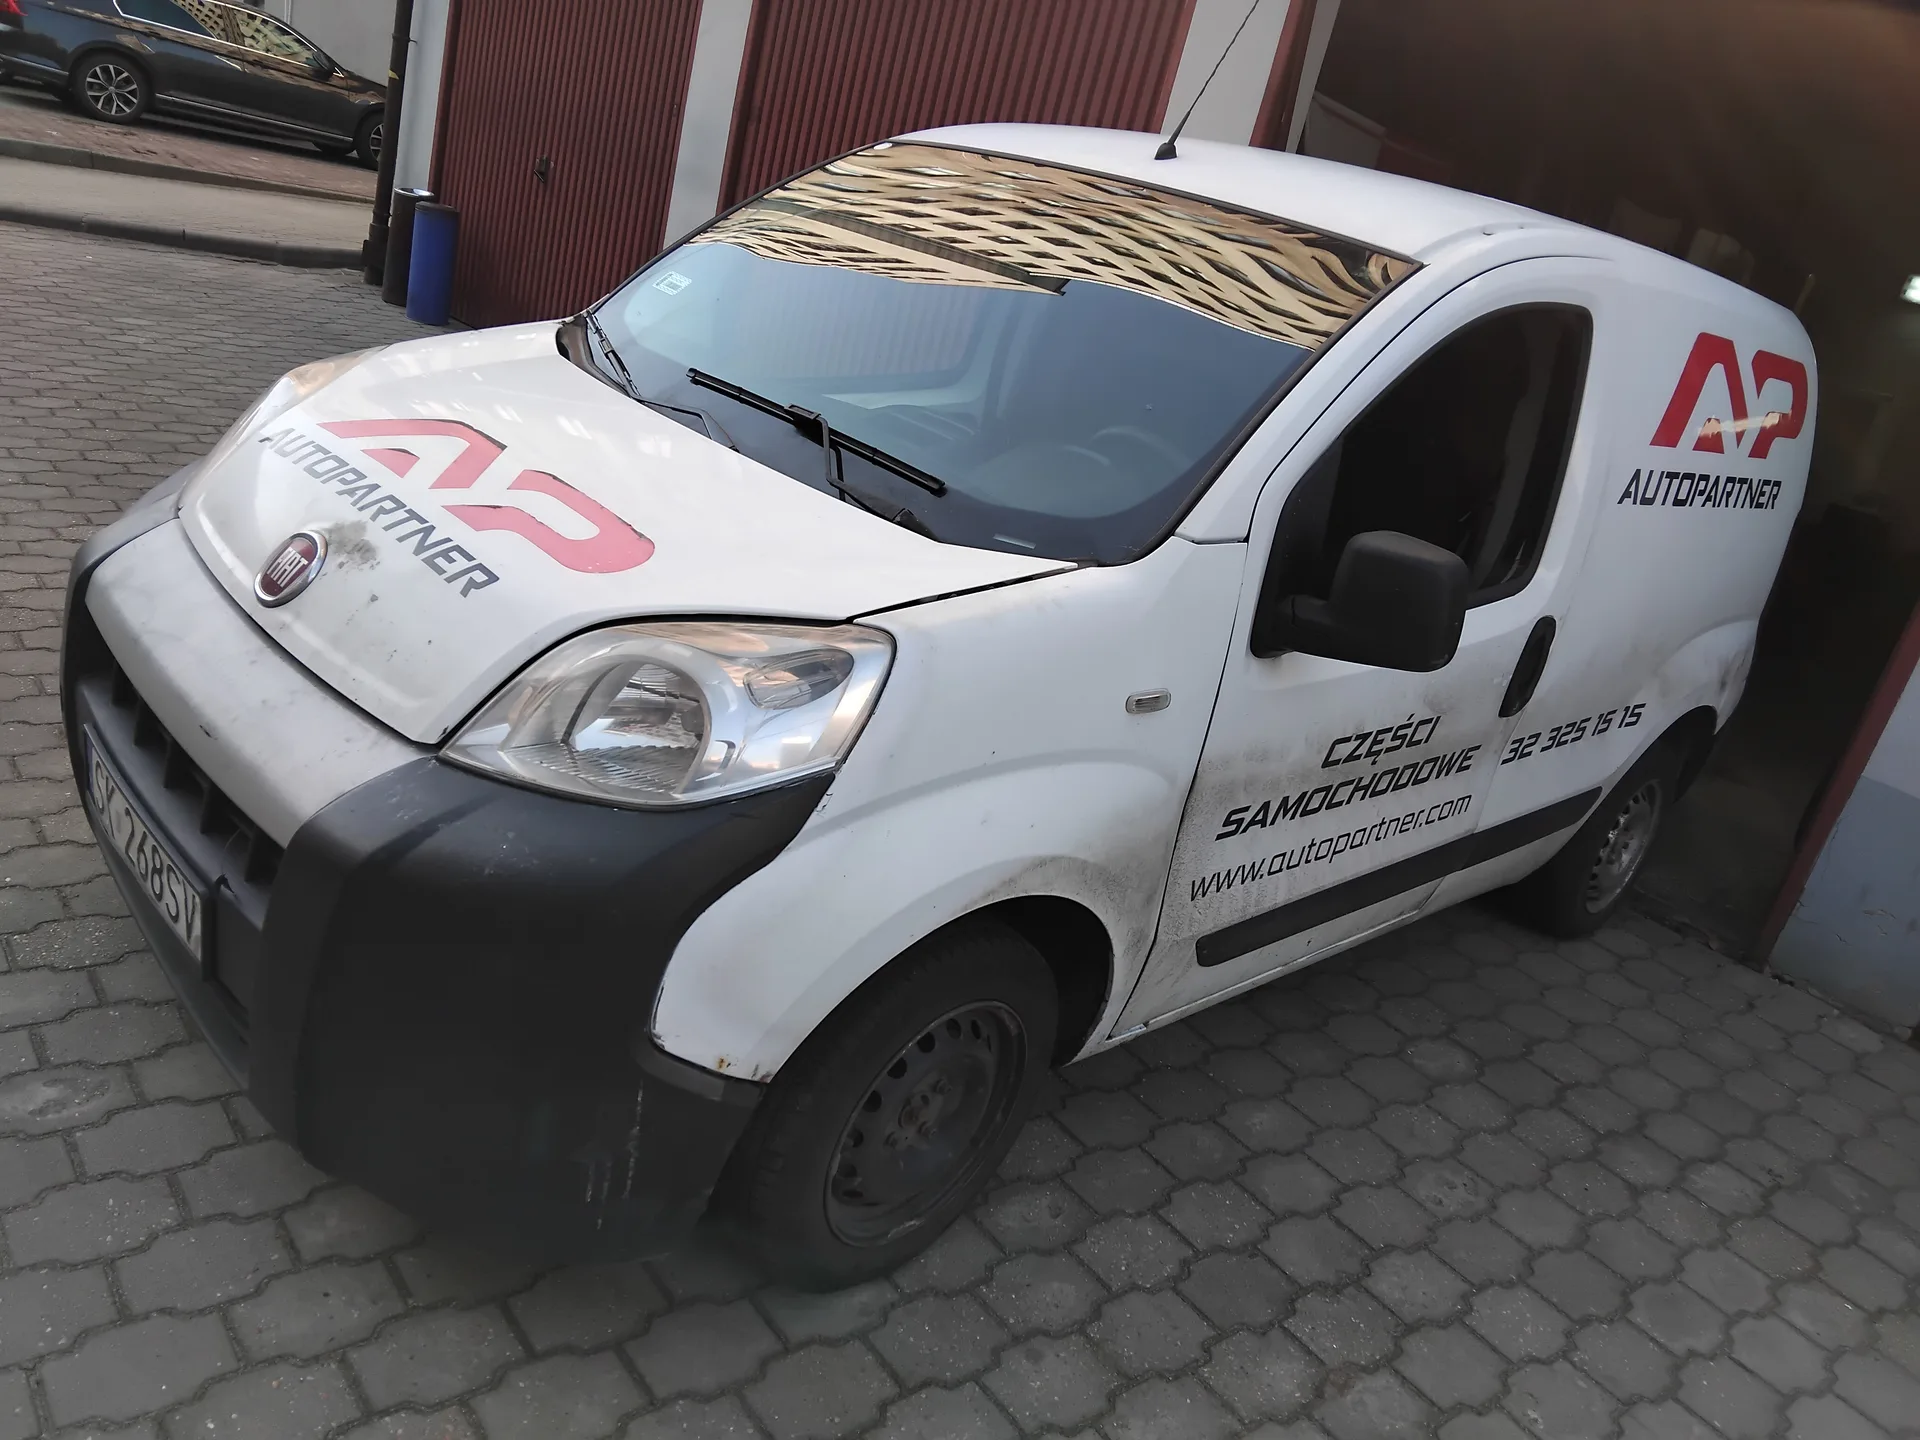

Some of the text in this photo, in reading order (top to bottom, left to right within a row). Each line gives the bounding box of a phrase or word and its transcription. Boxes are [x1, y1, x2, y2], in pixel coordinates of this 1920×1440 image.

[1649, 332, 1808, 459] AP
[257, 427, 500, 598] AUTOPARTNER
[1617, 468, 1782, 510] AUTOPARTNER
[266, 546, 309, 588] FIAT
[1320, 713, 1441, 768] CZĘŚCI
[1500, 702, 1647, 766] 32 325 15 15
[1214, 744, 1481, 841] SAMOCHODOWE
[95, 760, 197, 943] SK 268SV
[1190, 793, 1472, 901] www.autopartner.com
